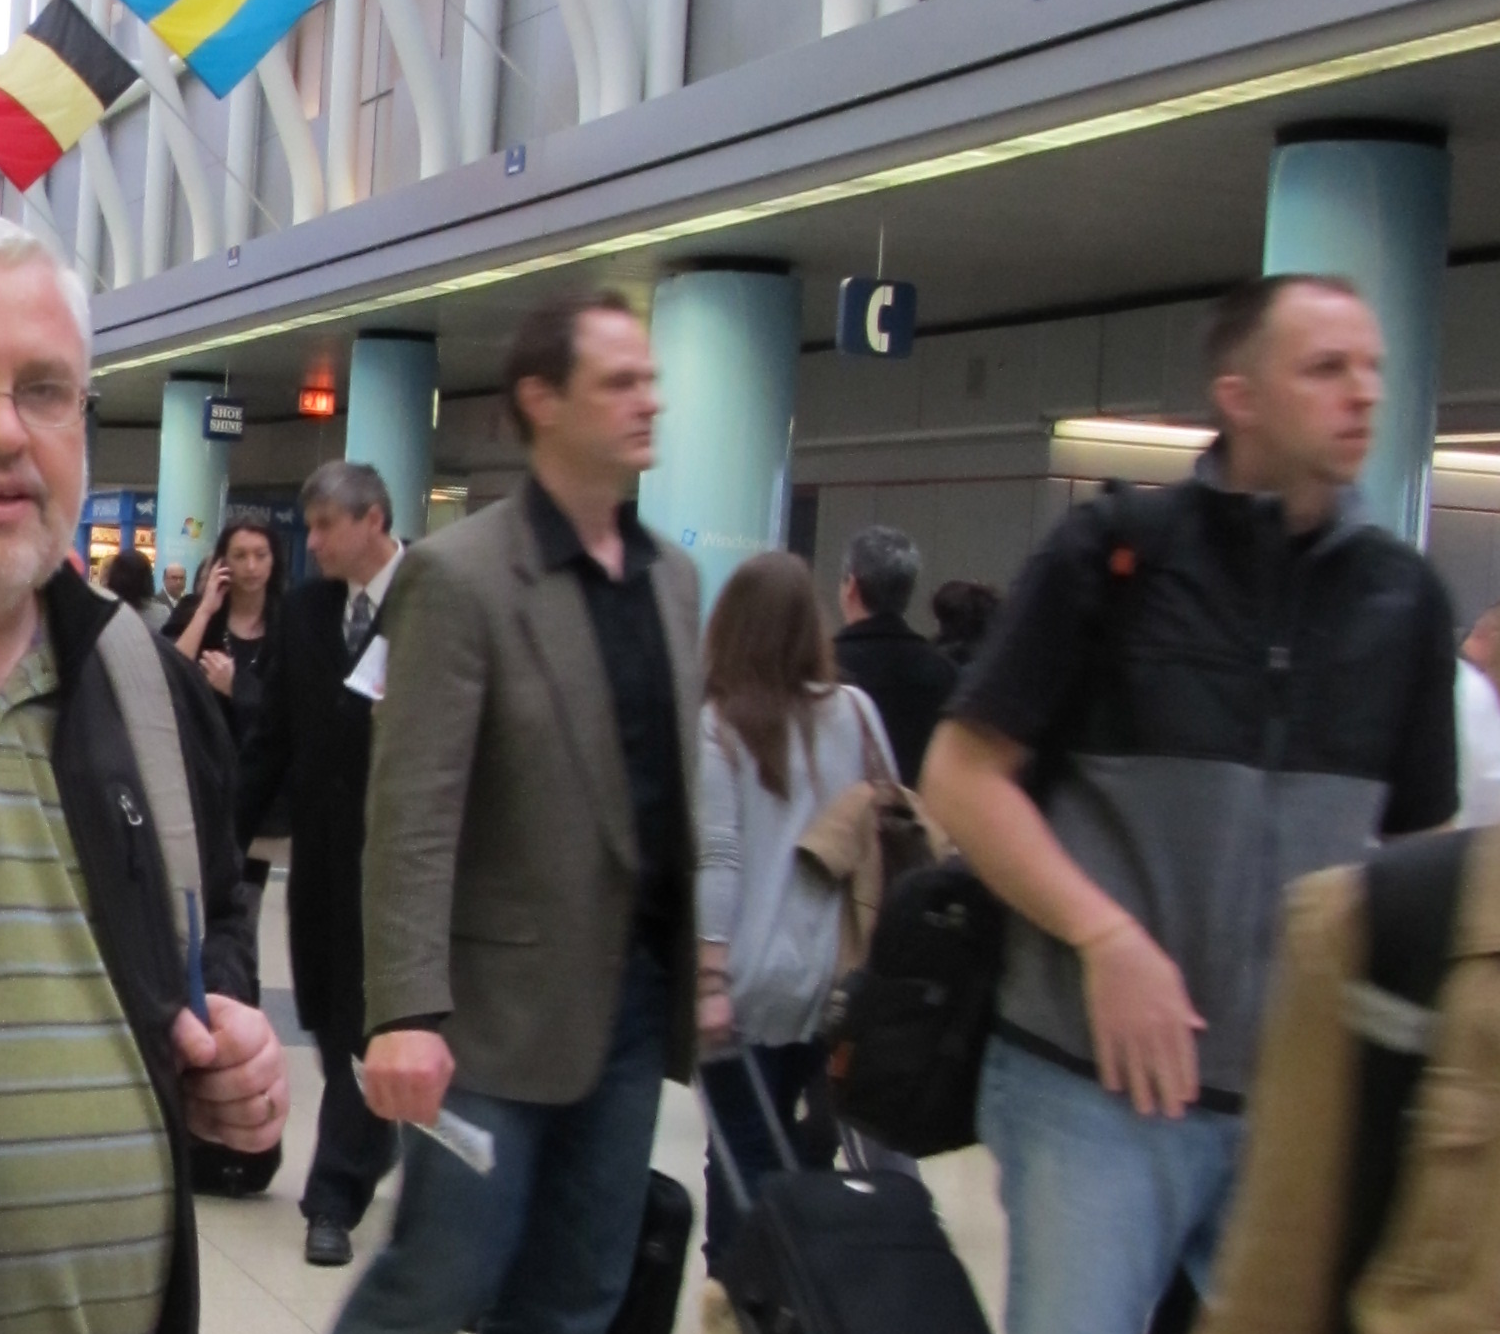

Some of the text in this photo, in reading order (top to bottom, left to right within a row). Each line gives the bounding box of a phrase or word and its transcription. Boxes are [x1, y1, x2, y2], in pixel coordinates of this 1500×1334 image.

[301, 390, 335, 412] EXIT
[211, 407, 243, 419] SHOE
[210, 418, 243, 431] SHINE
